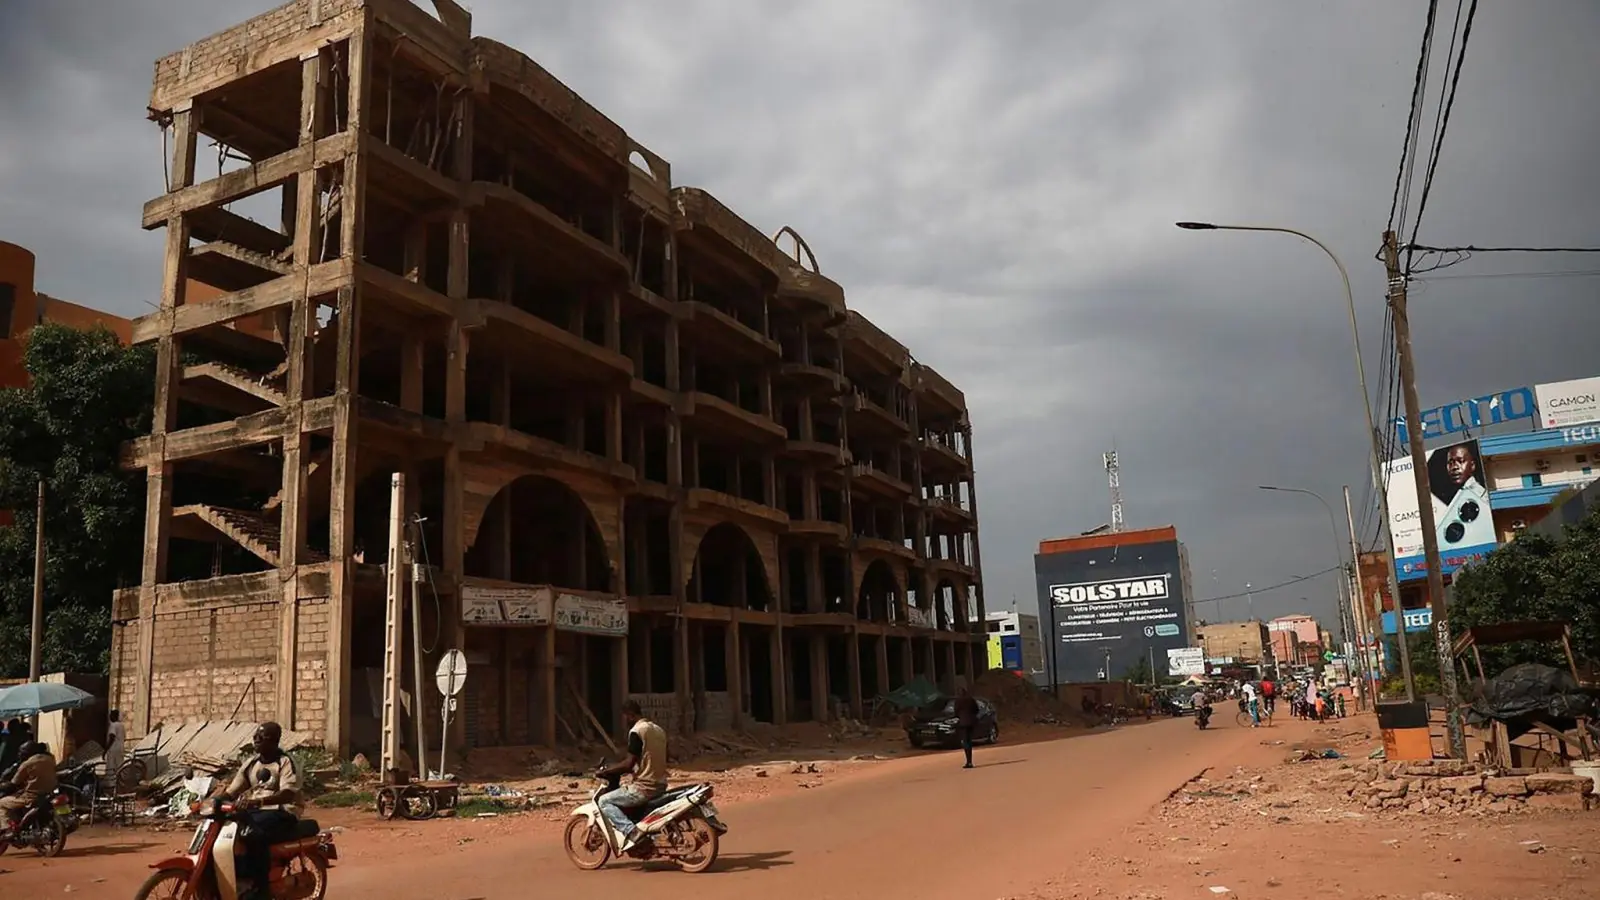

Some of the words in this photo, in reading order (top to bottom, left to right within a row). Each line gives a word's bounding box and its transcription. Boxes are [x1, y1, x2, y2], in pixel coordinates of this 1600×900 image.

[1550, 394, 1596, 408] CAMON
[1390, 387, 1533, 444] TECNO
[1053, 579, 1165, 604] SOLSTAR
[1089, 603, 1118, 611] Partenaire
